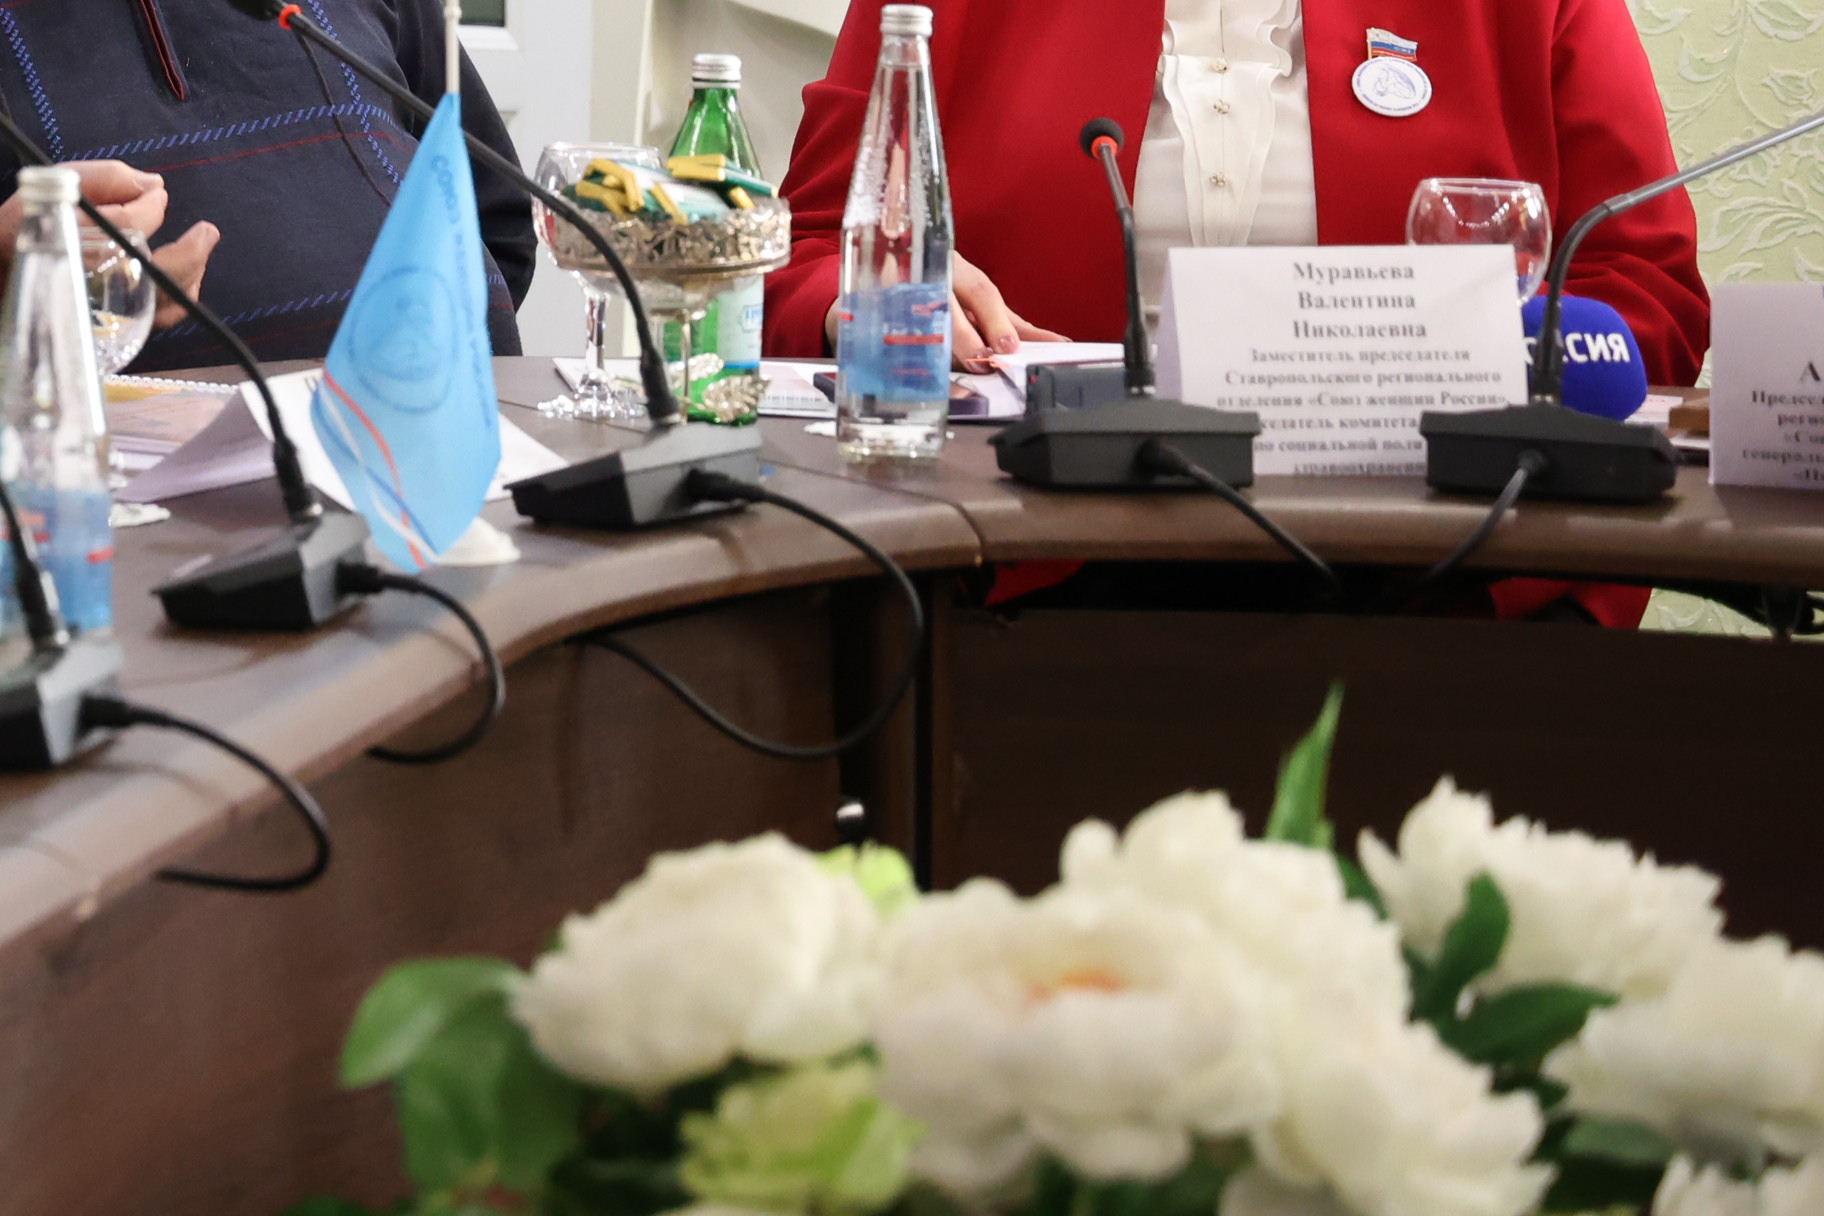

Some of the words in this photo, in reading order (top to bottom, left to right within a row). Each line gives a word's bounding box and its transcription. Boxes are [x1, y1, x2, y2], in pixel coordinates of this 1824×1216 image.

[1292, 261, 1415, 284] Муравьева
[1297, 291, 1416, 310] Валентина
[1292, 320, 1427, 339] Николаевна
[1249, 347, 1354, 363] Заместитель
[1359, 348, 1471, 366] председателя
[1224, 370, 1373, 388] Ставропольского
[1377, 371, 1502, 387] регионального
